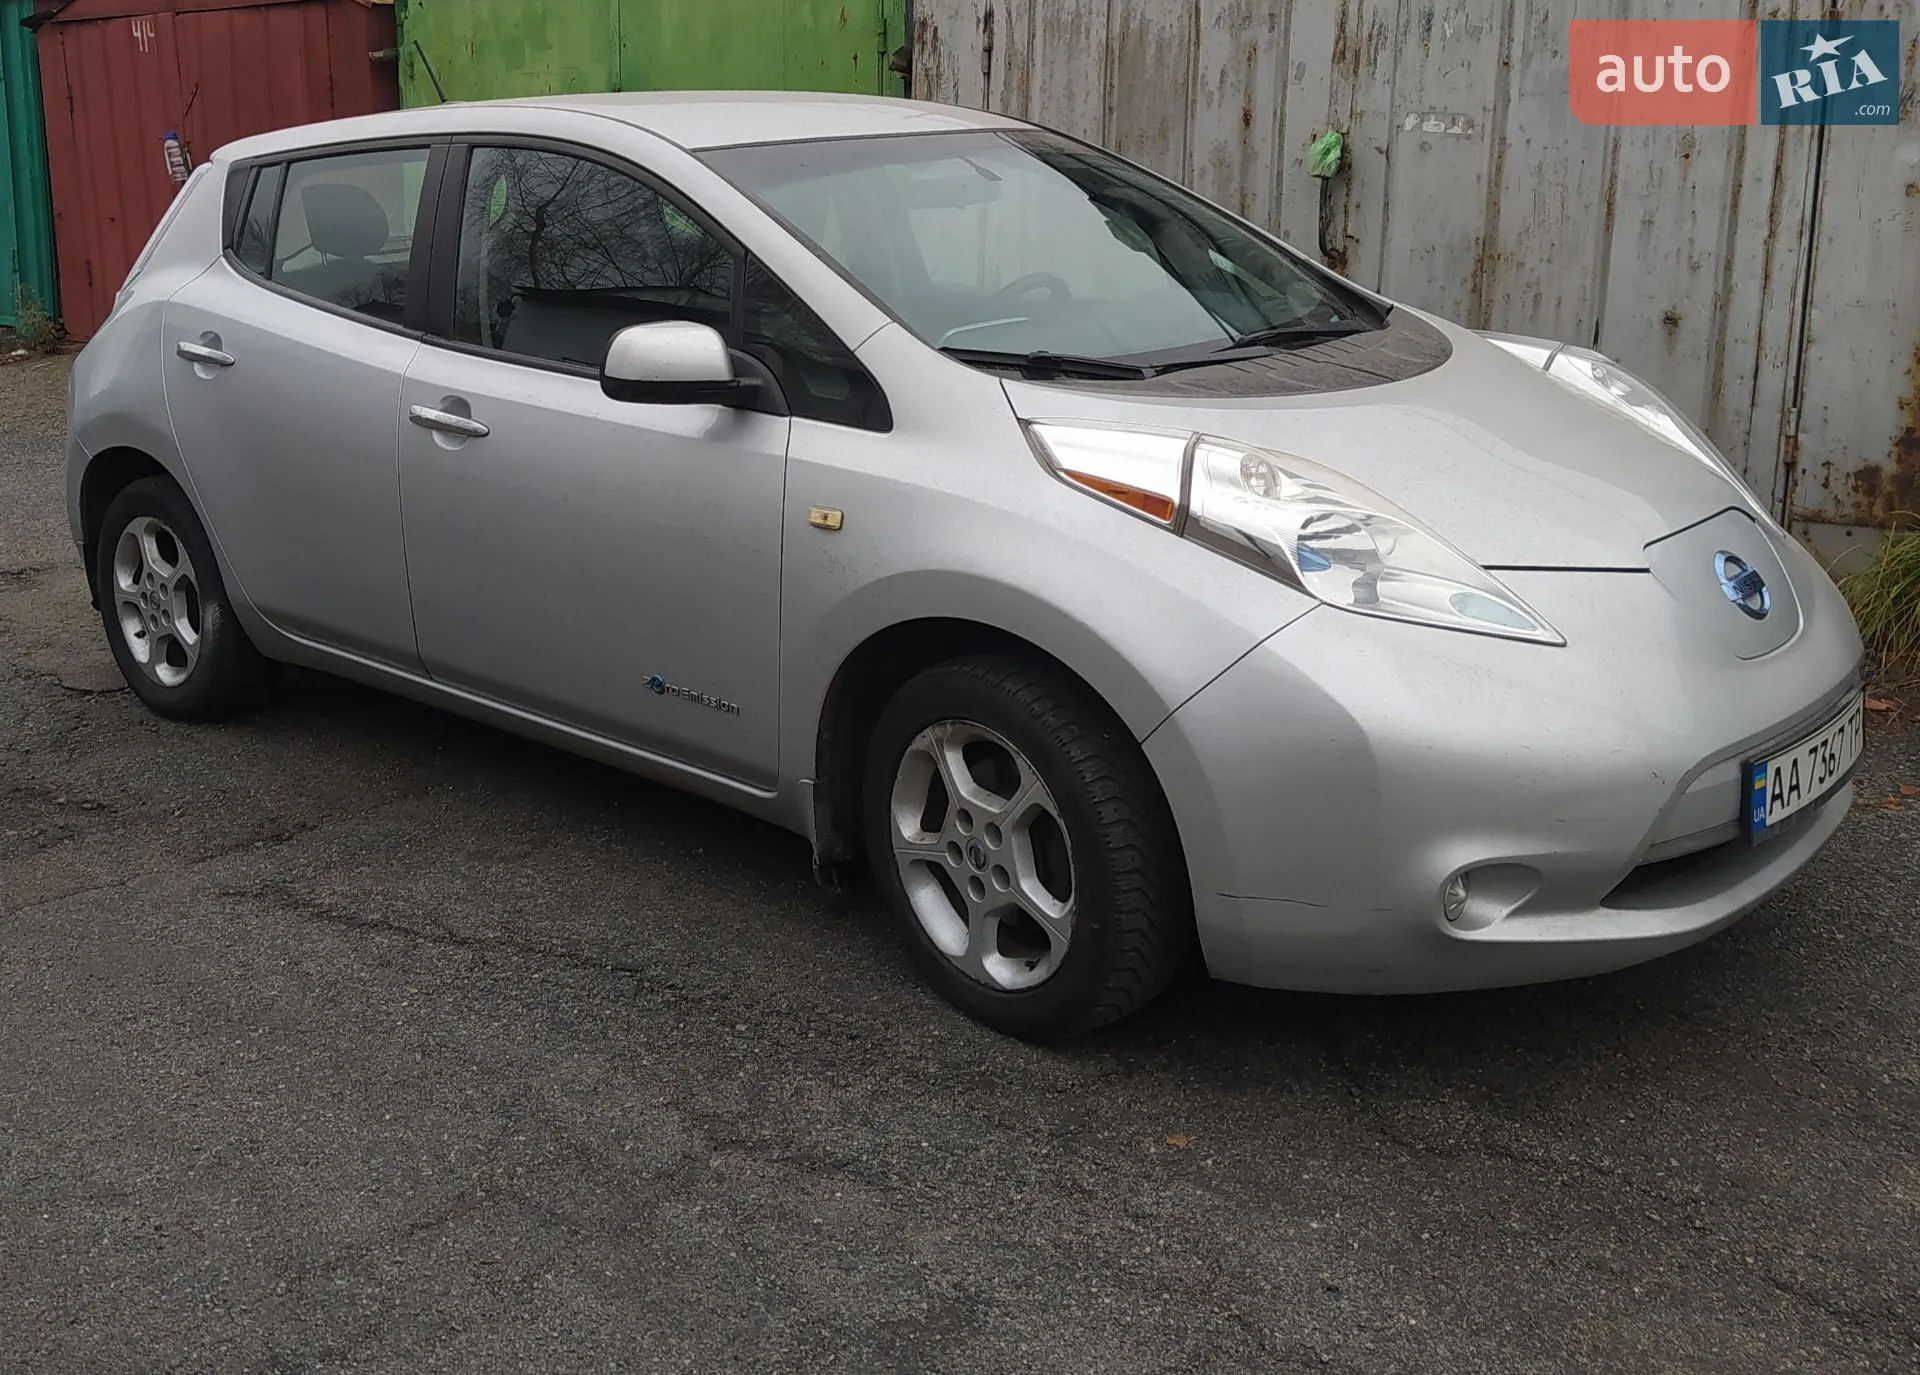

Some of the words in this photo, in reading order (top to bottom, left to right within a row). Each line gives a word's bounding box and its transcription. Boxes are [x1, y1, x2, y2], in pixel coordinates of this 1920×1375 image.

[131, 20, 157, 53] 414
[1768, 756, 1801, 817] AA
[1807, 725, 1845, 795] 7367
[1753, 805, 1766, 823] UA
